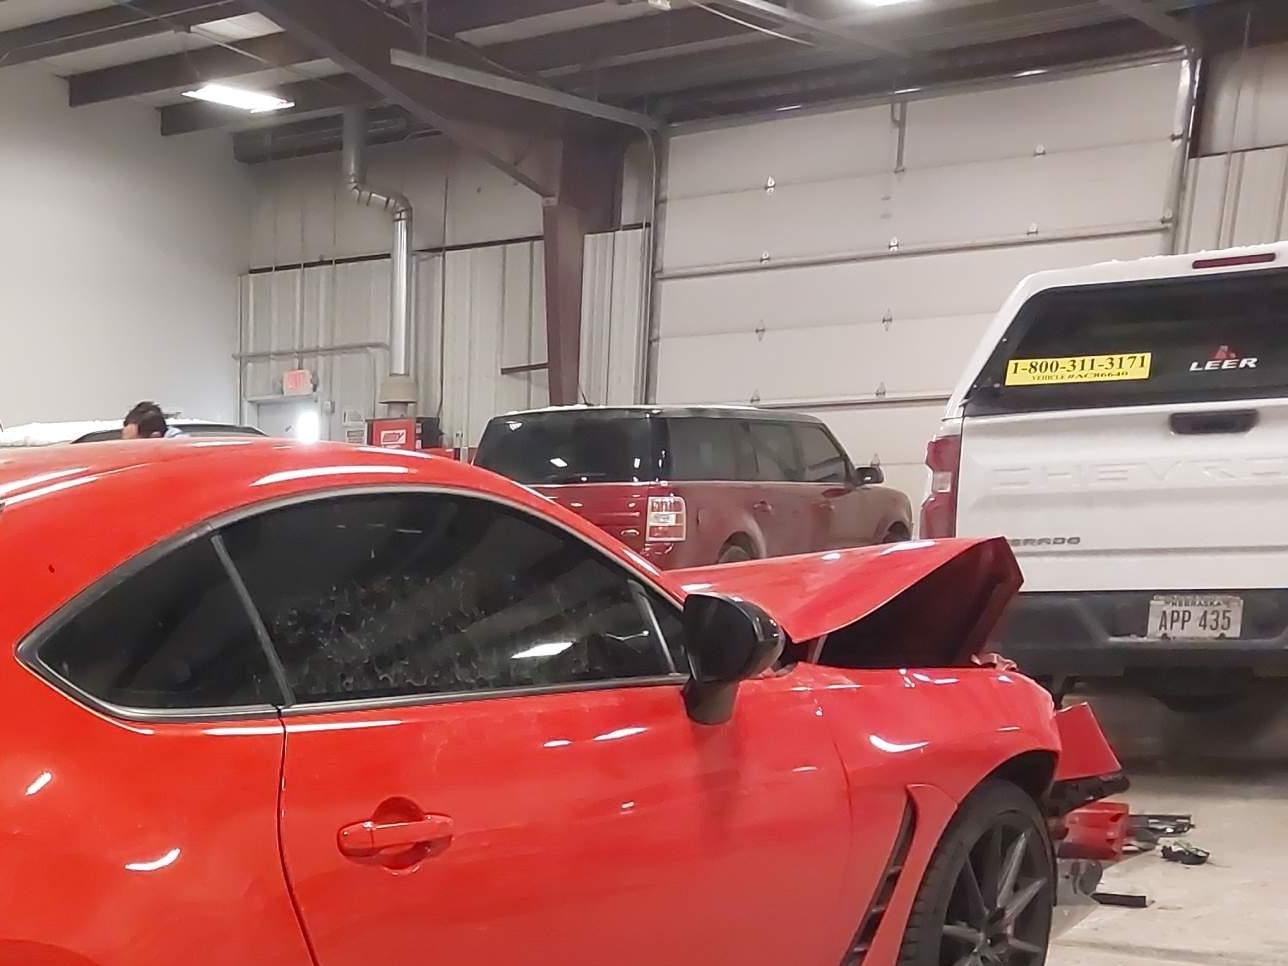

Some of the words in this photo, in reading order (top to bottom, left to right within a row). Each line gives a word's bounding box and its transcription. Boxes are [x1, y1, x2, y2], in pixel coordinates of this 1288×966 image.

[1012, 355, 1146, 375] 1-800-311-3171
[1189, 357, 1258, 372] LEER
[1158, 610, 1192, 631] APP
[1198, 609, 1232, 631] 435
